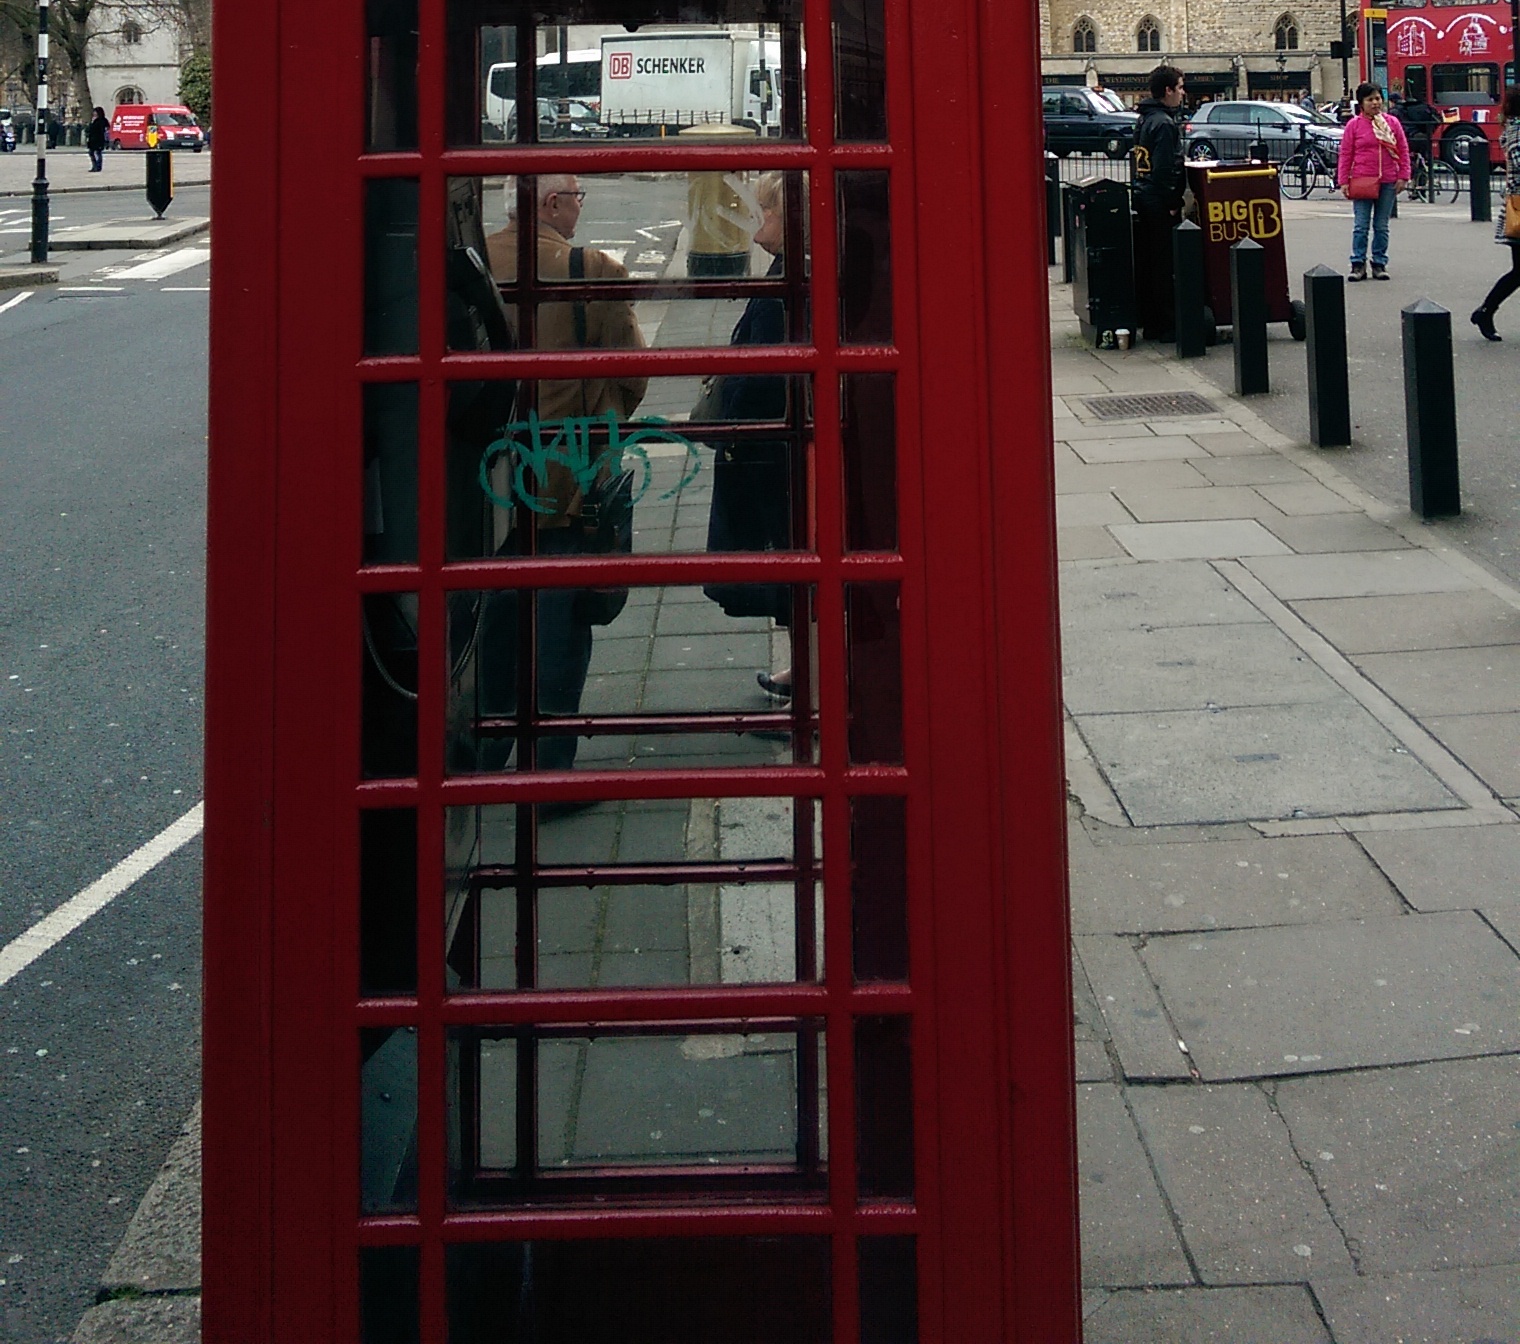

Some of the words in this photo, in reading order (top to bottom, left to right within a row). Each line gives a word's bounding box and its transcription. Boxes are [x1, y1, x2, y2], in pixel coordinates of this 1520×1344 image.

[612, 57, 629, 75] DB
[636, 57, 705, 74] SCHENKER
[1104, 76, 1150, 84] WESTMINSTE
[1208, 200, 1247, 222] BIG
[1210, 221, 1250, 242] BUS
